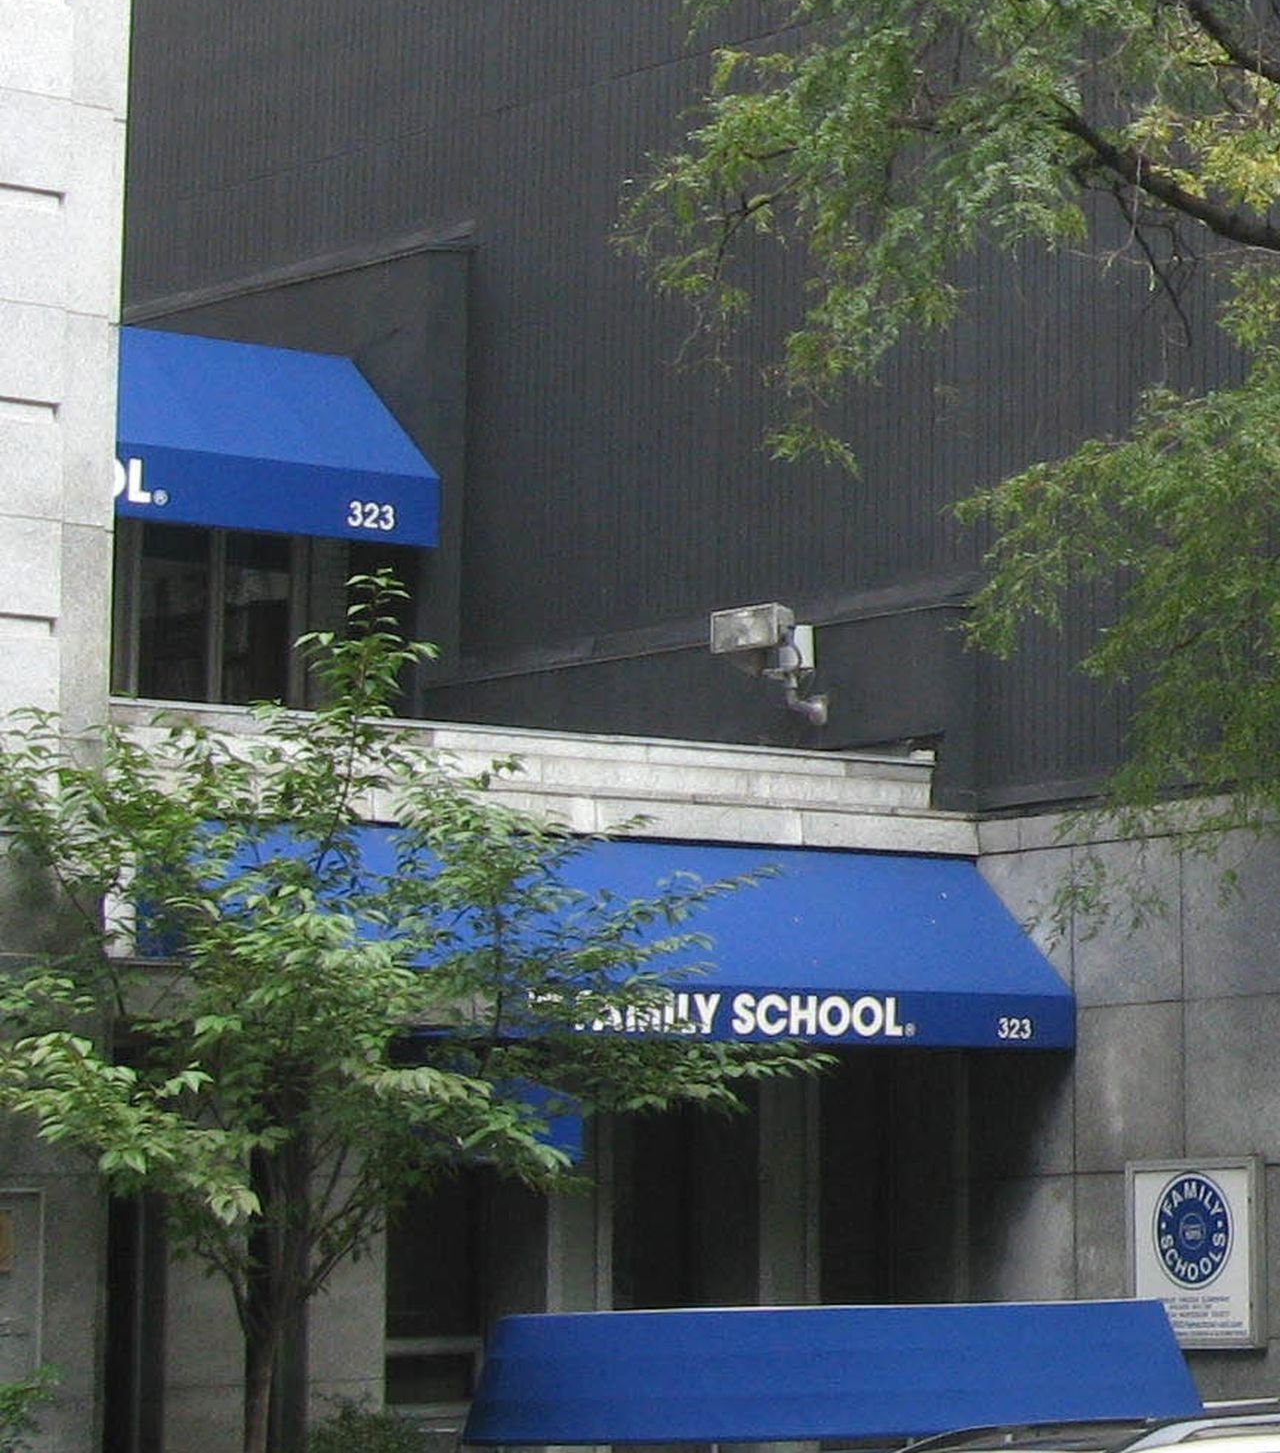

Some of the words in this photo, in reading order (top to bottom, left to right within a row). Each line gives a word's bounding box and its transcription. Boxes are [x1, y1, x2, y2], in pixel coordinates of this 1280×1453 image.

[347, 500, 396, 531] 323
[997, 1017, 1032, 1039] 323
[1161, 1180, 1223, 1218] FAMILY
[1160, 1232, 1226, 1281] SCHOOLS
